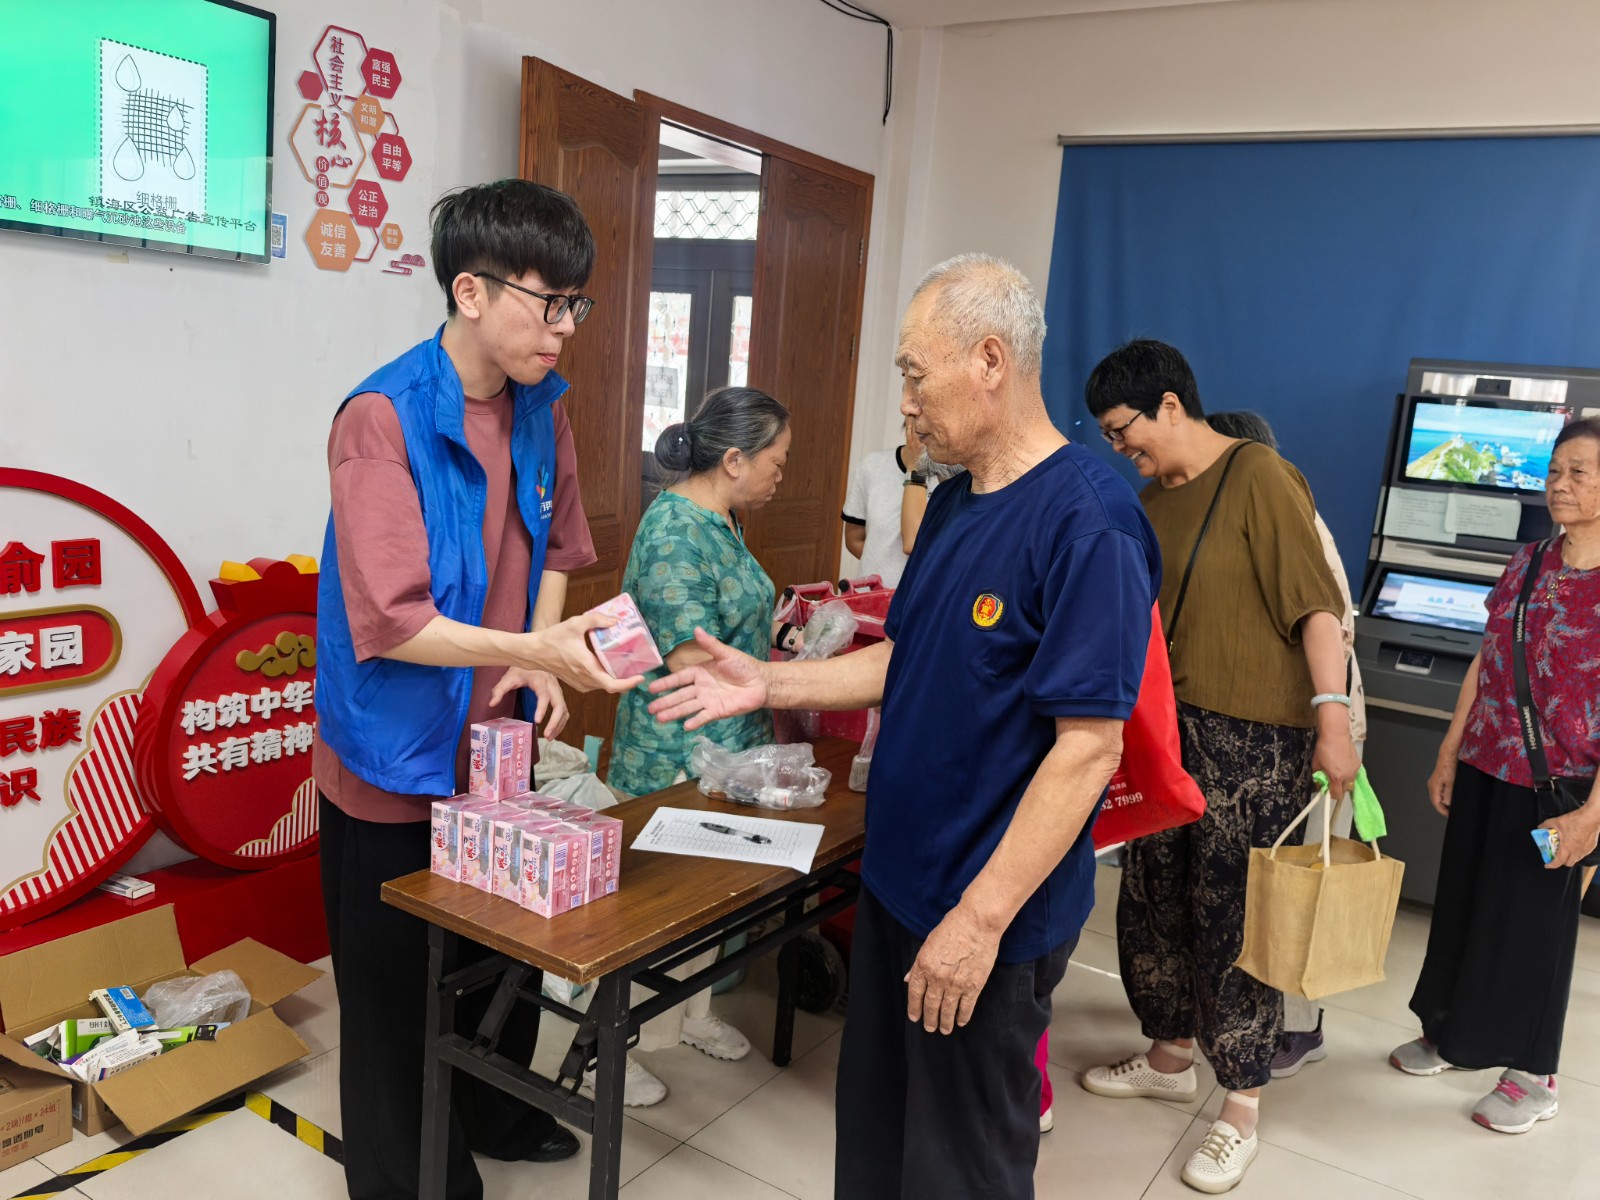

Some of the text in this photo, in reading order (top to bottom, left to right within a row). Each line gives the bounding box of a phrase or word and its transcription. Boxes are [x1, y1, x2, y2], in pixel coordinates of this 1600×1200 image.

[328, 36, 344, 110] 社会主义
[371, 58, 391, 74] 富强
[371, 74, 391, 89] 民主
[360, 103, 377, 114] 文明
[382, 143, 402, 157] 自由
[382, 158, 402, 172] 平等
[316, 158, 329, 206] 价值观
[136, 190, 177, 209] 细格栅
[358, 189, 378, 203] 公正
[358, 204, 378, 218] 法治
[320, 222, 346, 239] 诚信
[320, 241, 346, 258] 友善
[0, 625, 84, 676] 家园
[180, 679, 316, 735] 构筑中华
[0, 708, 82, 757] 民族
[182, 722, 316, 780] 共有精神
[1115, 792, 1144, 807] 7999
